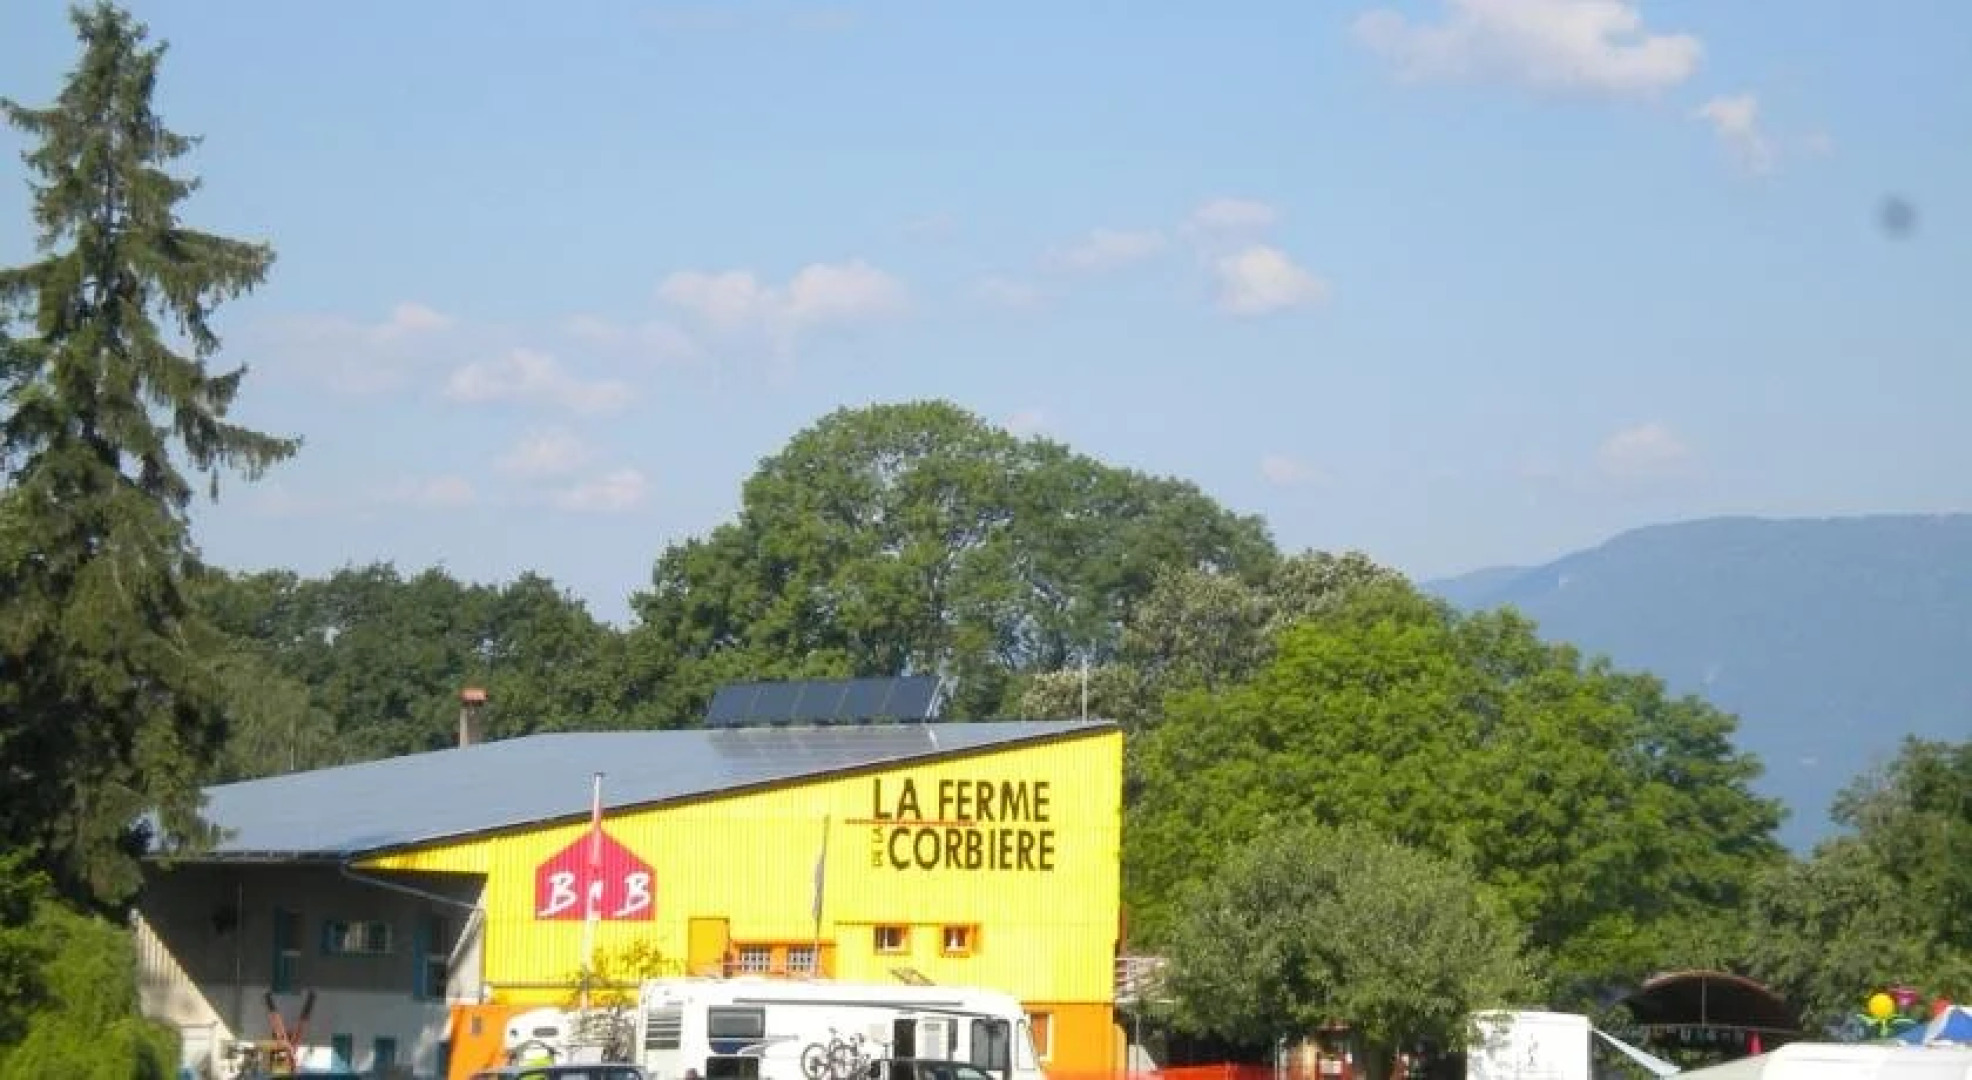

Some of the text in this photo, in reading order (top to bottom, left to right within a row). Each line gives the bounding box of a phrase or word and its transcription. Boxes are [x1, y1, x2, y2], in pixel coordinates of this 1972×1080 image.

[873, 778, 1049, 822] LA FERME
[888, 827, 1054, 871] CORBIERE
